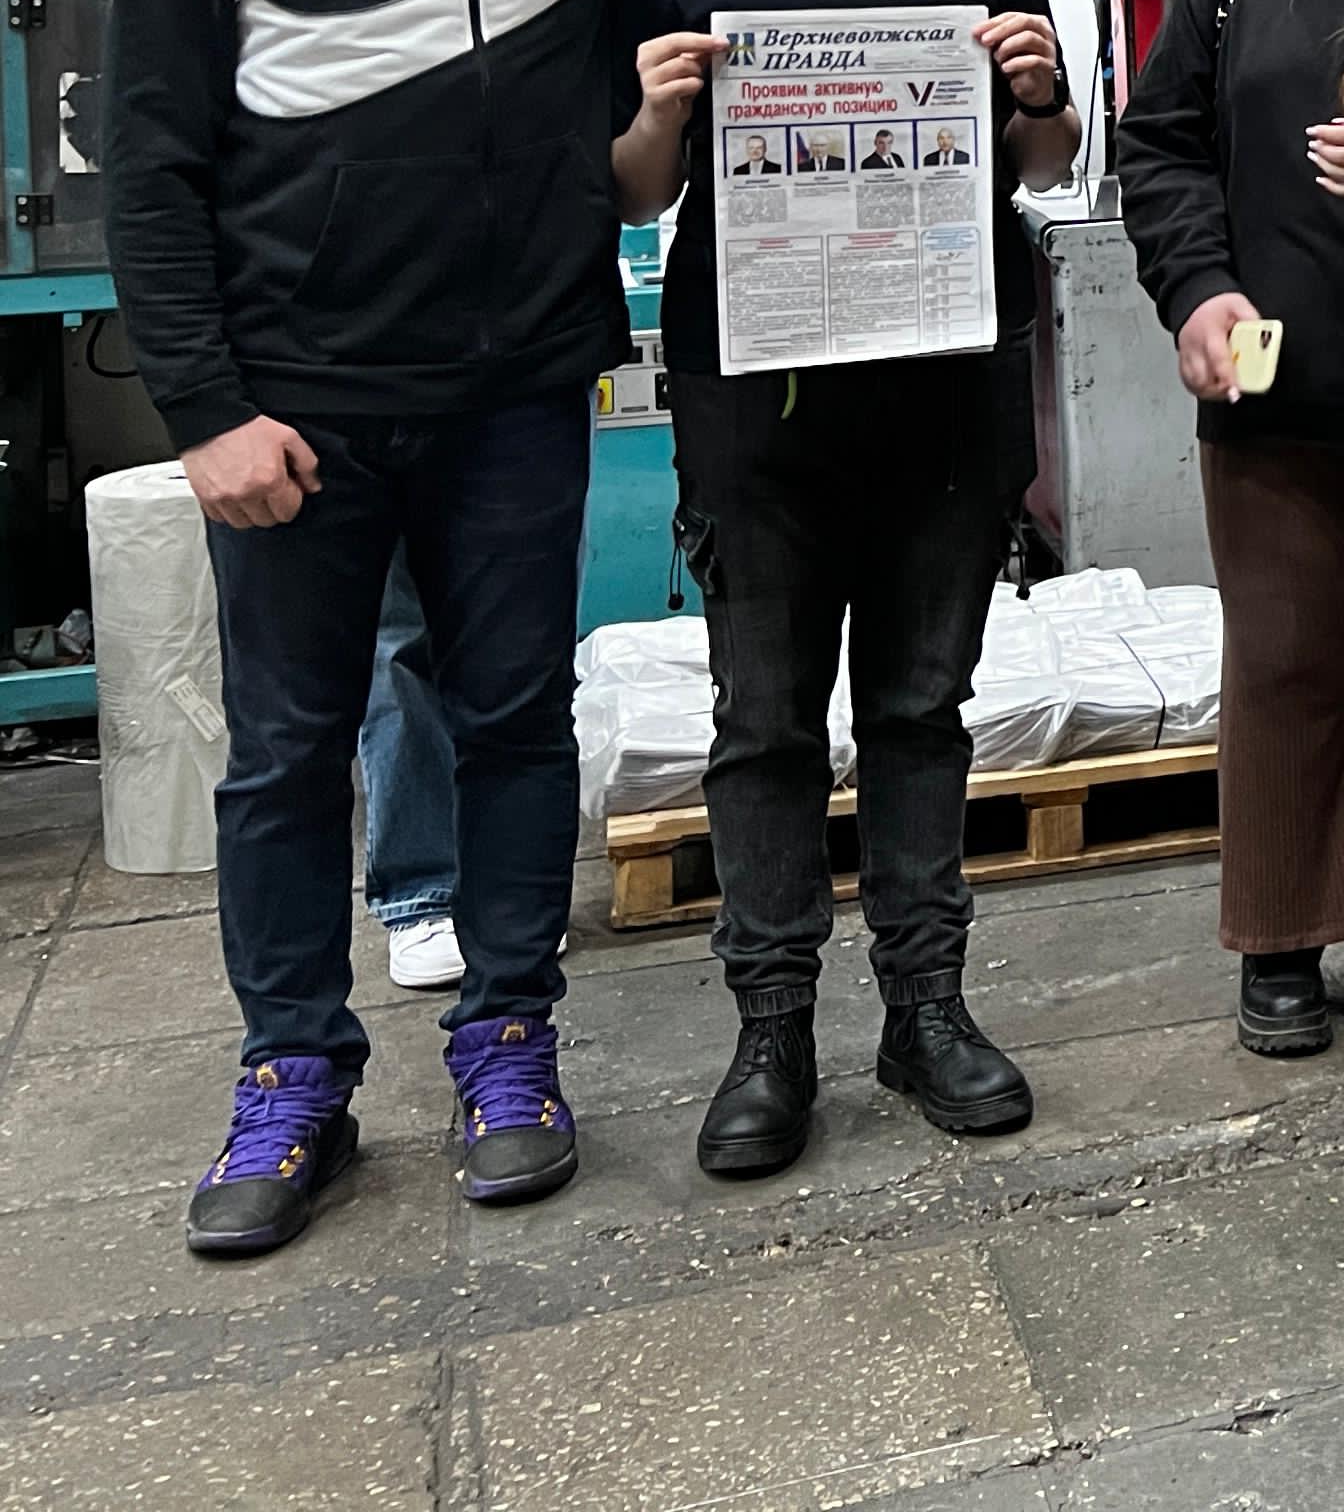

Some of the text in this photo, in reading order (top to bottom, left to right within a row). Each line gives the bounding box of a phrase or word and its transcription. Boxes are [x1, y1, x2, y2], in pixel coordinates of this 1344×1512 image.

[761, 26, 956, 52] Верхневолжская
[761, 49, 867, 72] ПРАВДА
[741, 80, 883, 101] Проявим активную
[727, 97, 898, 122] гражданскую позицию
